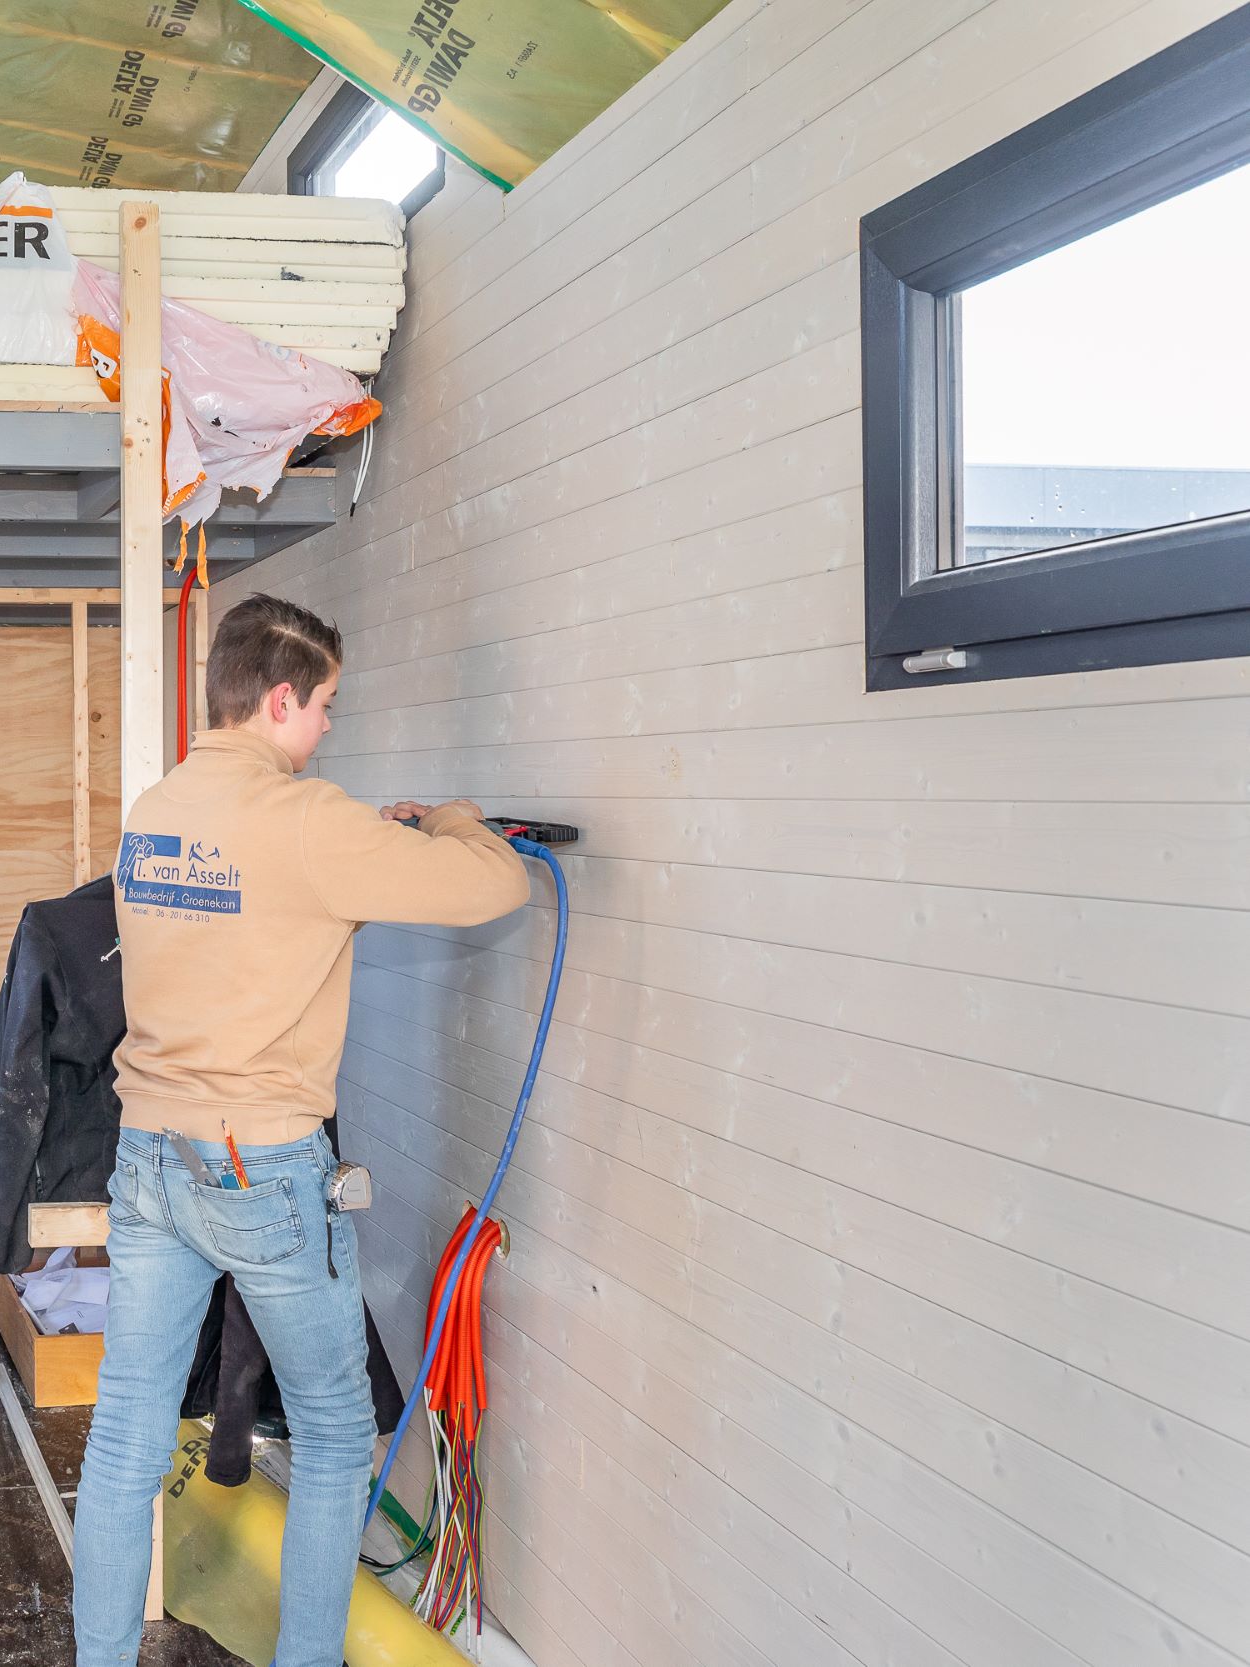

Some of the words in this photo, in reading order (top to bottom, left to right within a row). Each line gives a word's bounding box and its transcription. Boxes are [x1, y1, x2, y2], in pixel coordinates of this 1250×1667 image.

[153, 865, 180, 881] van
[186, 862, 241, 888] Asselt
[128, 887, 176, 907] Bouwbedrijf
[181, 893, 236, 910] Groenekan
